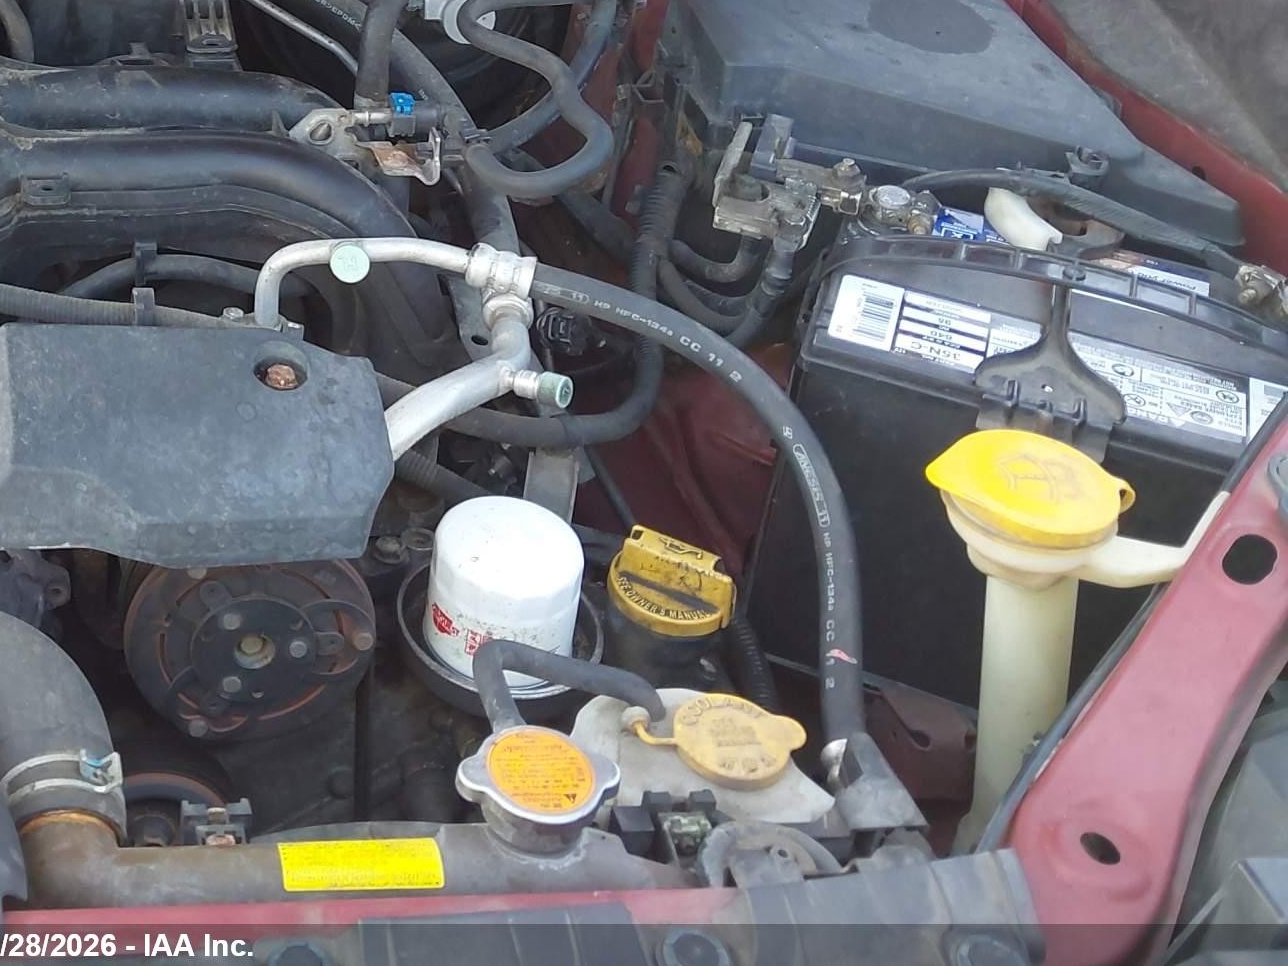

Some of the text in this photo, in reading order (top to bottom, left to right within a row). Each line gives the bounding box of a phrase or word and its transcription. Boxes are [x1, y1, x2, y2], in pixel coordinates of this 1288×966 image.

[594, 300, 611, 310] HP
[679, 336, 702, 353] CC
[708, 352, 724, 368] 11
[729, 370, 744, 384] 2
[823, 532, 832, 548] HP
[669, 609, 712, 620] MANUAL
[826, 620, 835, 642] CC
[825, 677, 836, 690] 2
